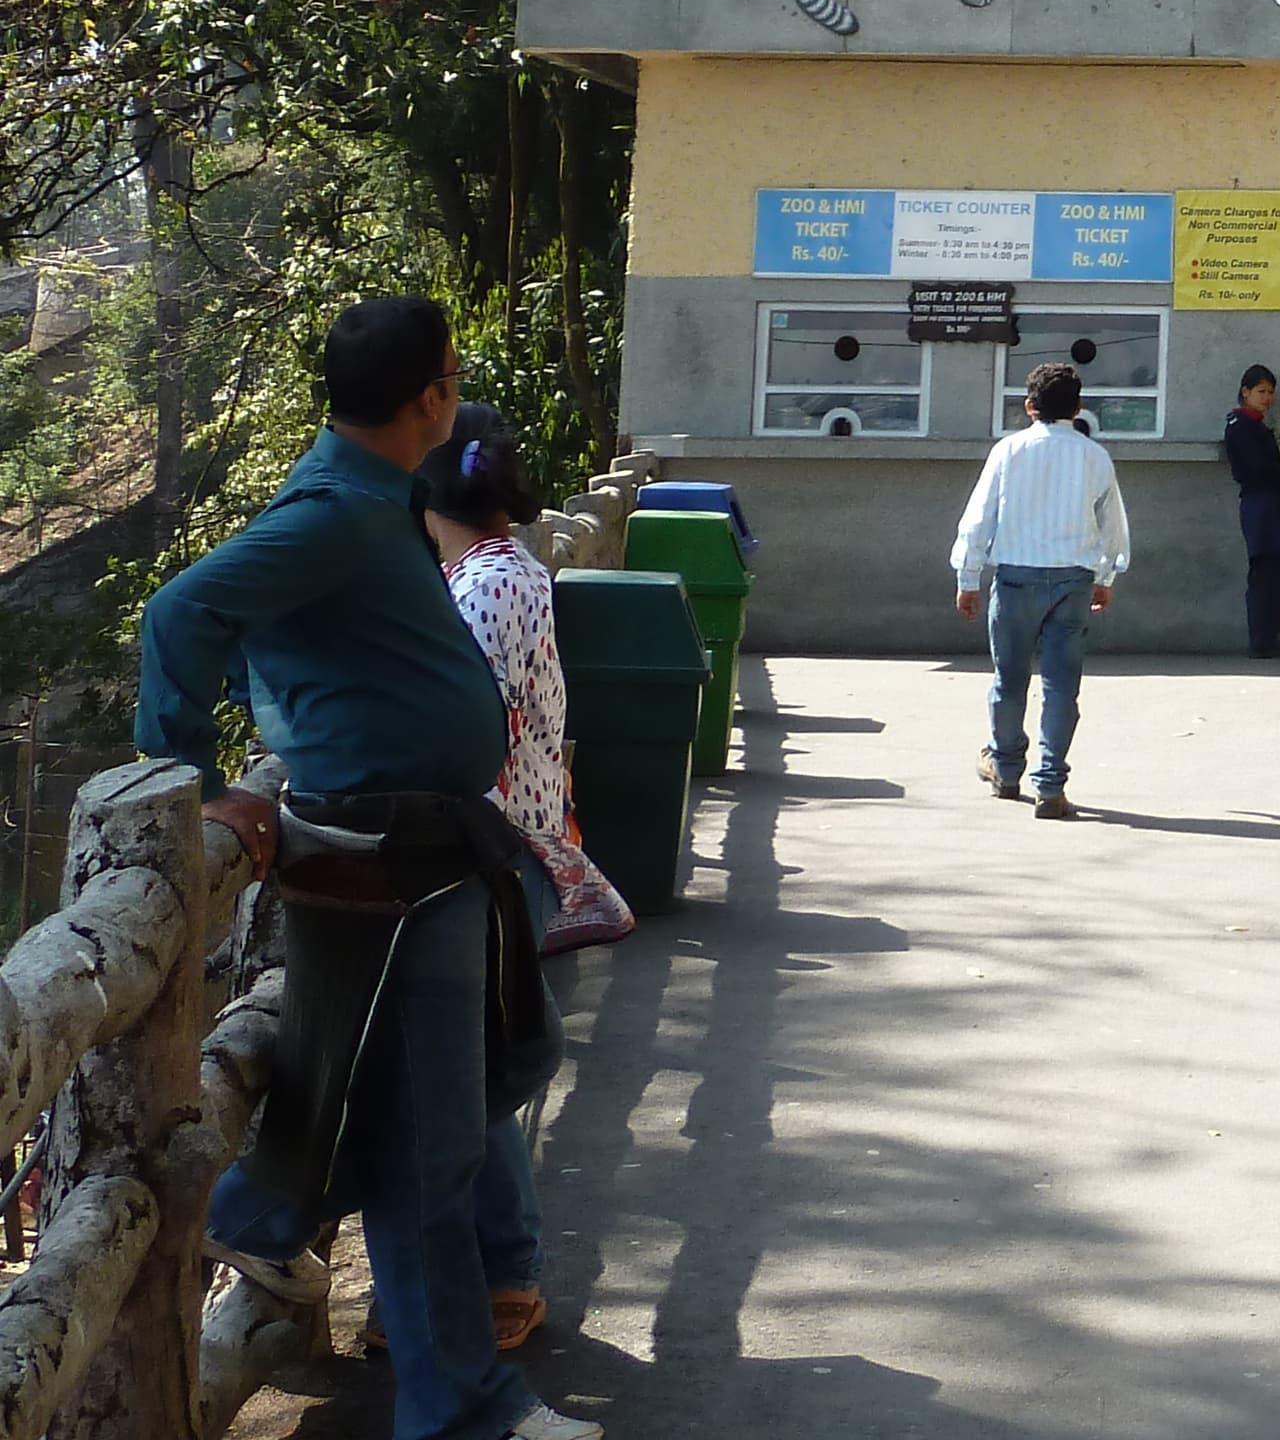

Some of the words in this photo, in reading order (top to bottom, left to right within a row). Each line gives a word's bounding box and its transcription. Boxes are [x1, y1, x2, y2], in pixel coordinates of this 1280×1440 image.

[781, 198, 815, 214] ZOO
[819, 198, 831, 214] &
[834, 199, 865, 215] HMI
[898, 200, 953, 214] TICKET
[957, 202, 1031, 215] COUNTER
[1061, 205, 1095, 220] ZOO
[1098, 205, 1111, 220] &
[1114, 206, 1145, 221] HMI
[1180, 207, 1221, 217] Camera
[1224, 207, 1268, 219] Charges
[796, 222, 849, 238] TICKET
[1188, 221, 1210, 230] Non
[1213, 221, 1277, 231] Commercial
[1075, 228, 1129, 244] TICKET
[1206, 234, 1258, 245] Purposes
[1015, 242, 1030, 251] pm
[792, 246, 813, 261] Rs.
[817, 246, 849, 261] 40/-
[1014, 253, 1029, 261] pm
[1072, 253, 1094, 266] Rs.
[1098, 252, 1129, 267] 40/-
[1200, 259, 1228, 269] Video
[1230, 259, 1269, 269] Camera
[1200, 272, 1219, 281] Still
[1221, 272, 1259, 281] Camera
[915, 291, 939, 302] VISIT
[955, 292, 976, 302] ZOO
[1199, 290, 1214, 300] Rs.
[1239, 290, 1261, 301] only
